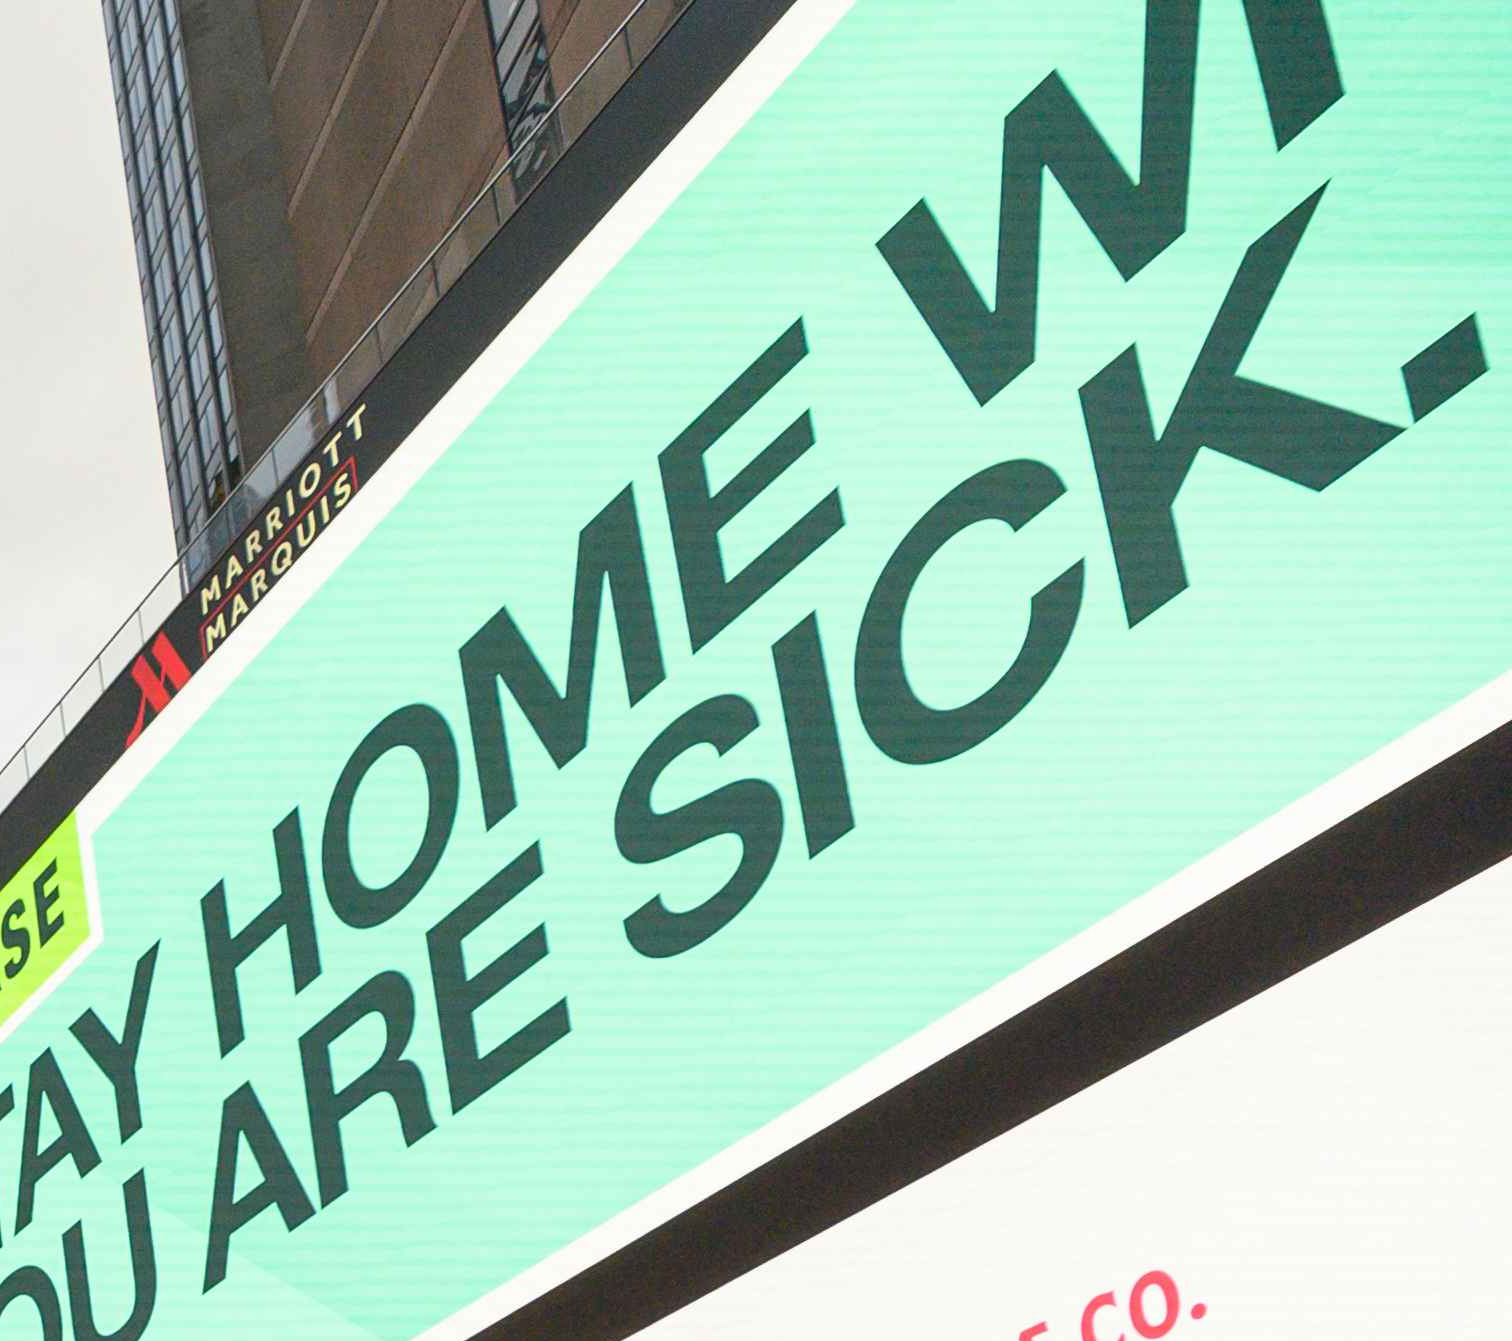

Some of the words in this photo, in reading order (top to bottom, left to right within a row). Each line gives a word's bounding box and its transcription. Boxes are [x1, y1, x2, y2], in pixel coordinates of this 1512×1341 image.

[200, 403, 368, 615] MARRIOTT
[201, 314, 847, 1062] HOME
[203, 842, 572, 1297] ARE
[616, 181, 1491, 962] SICK.
[205, 471, 354, 657] MARQUIS
